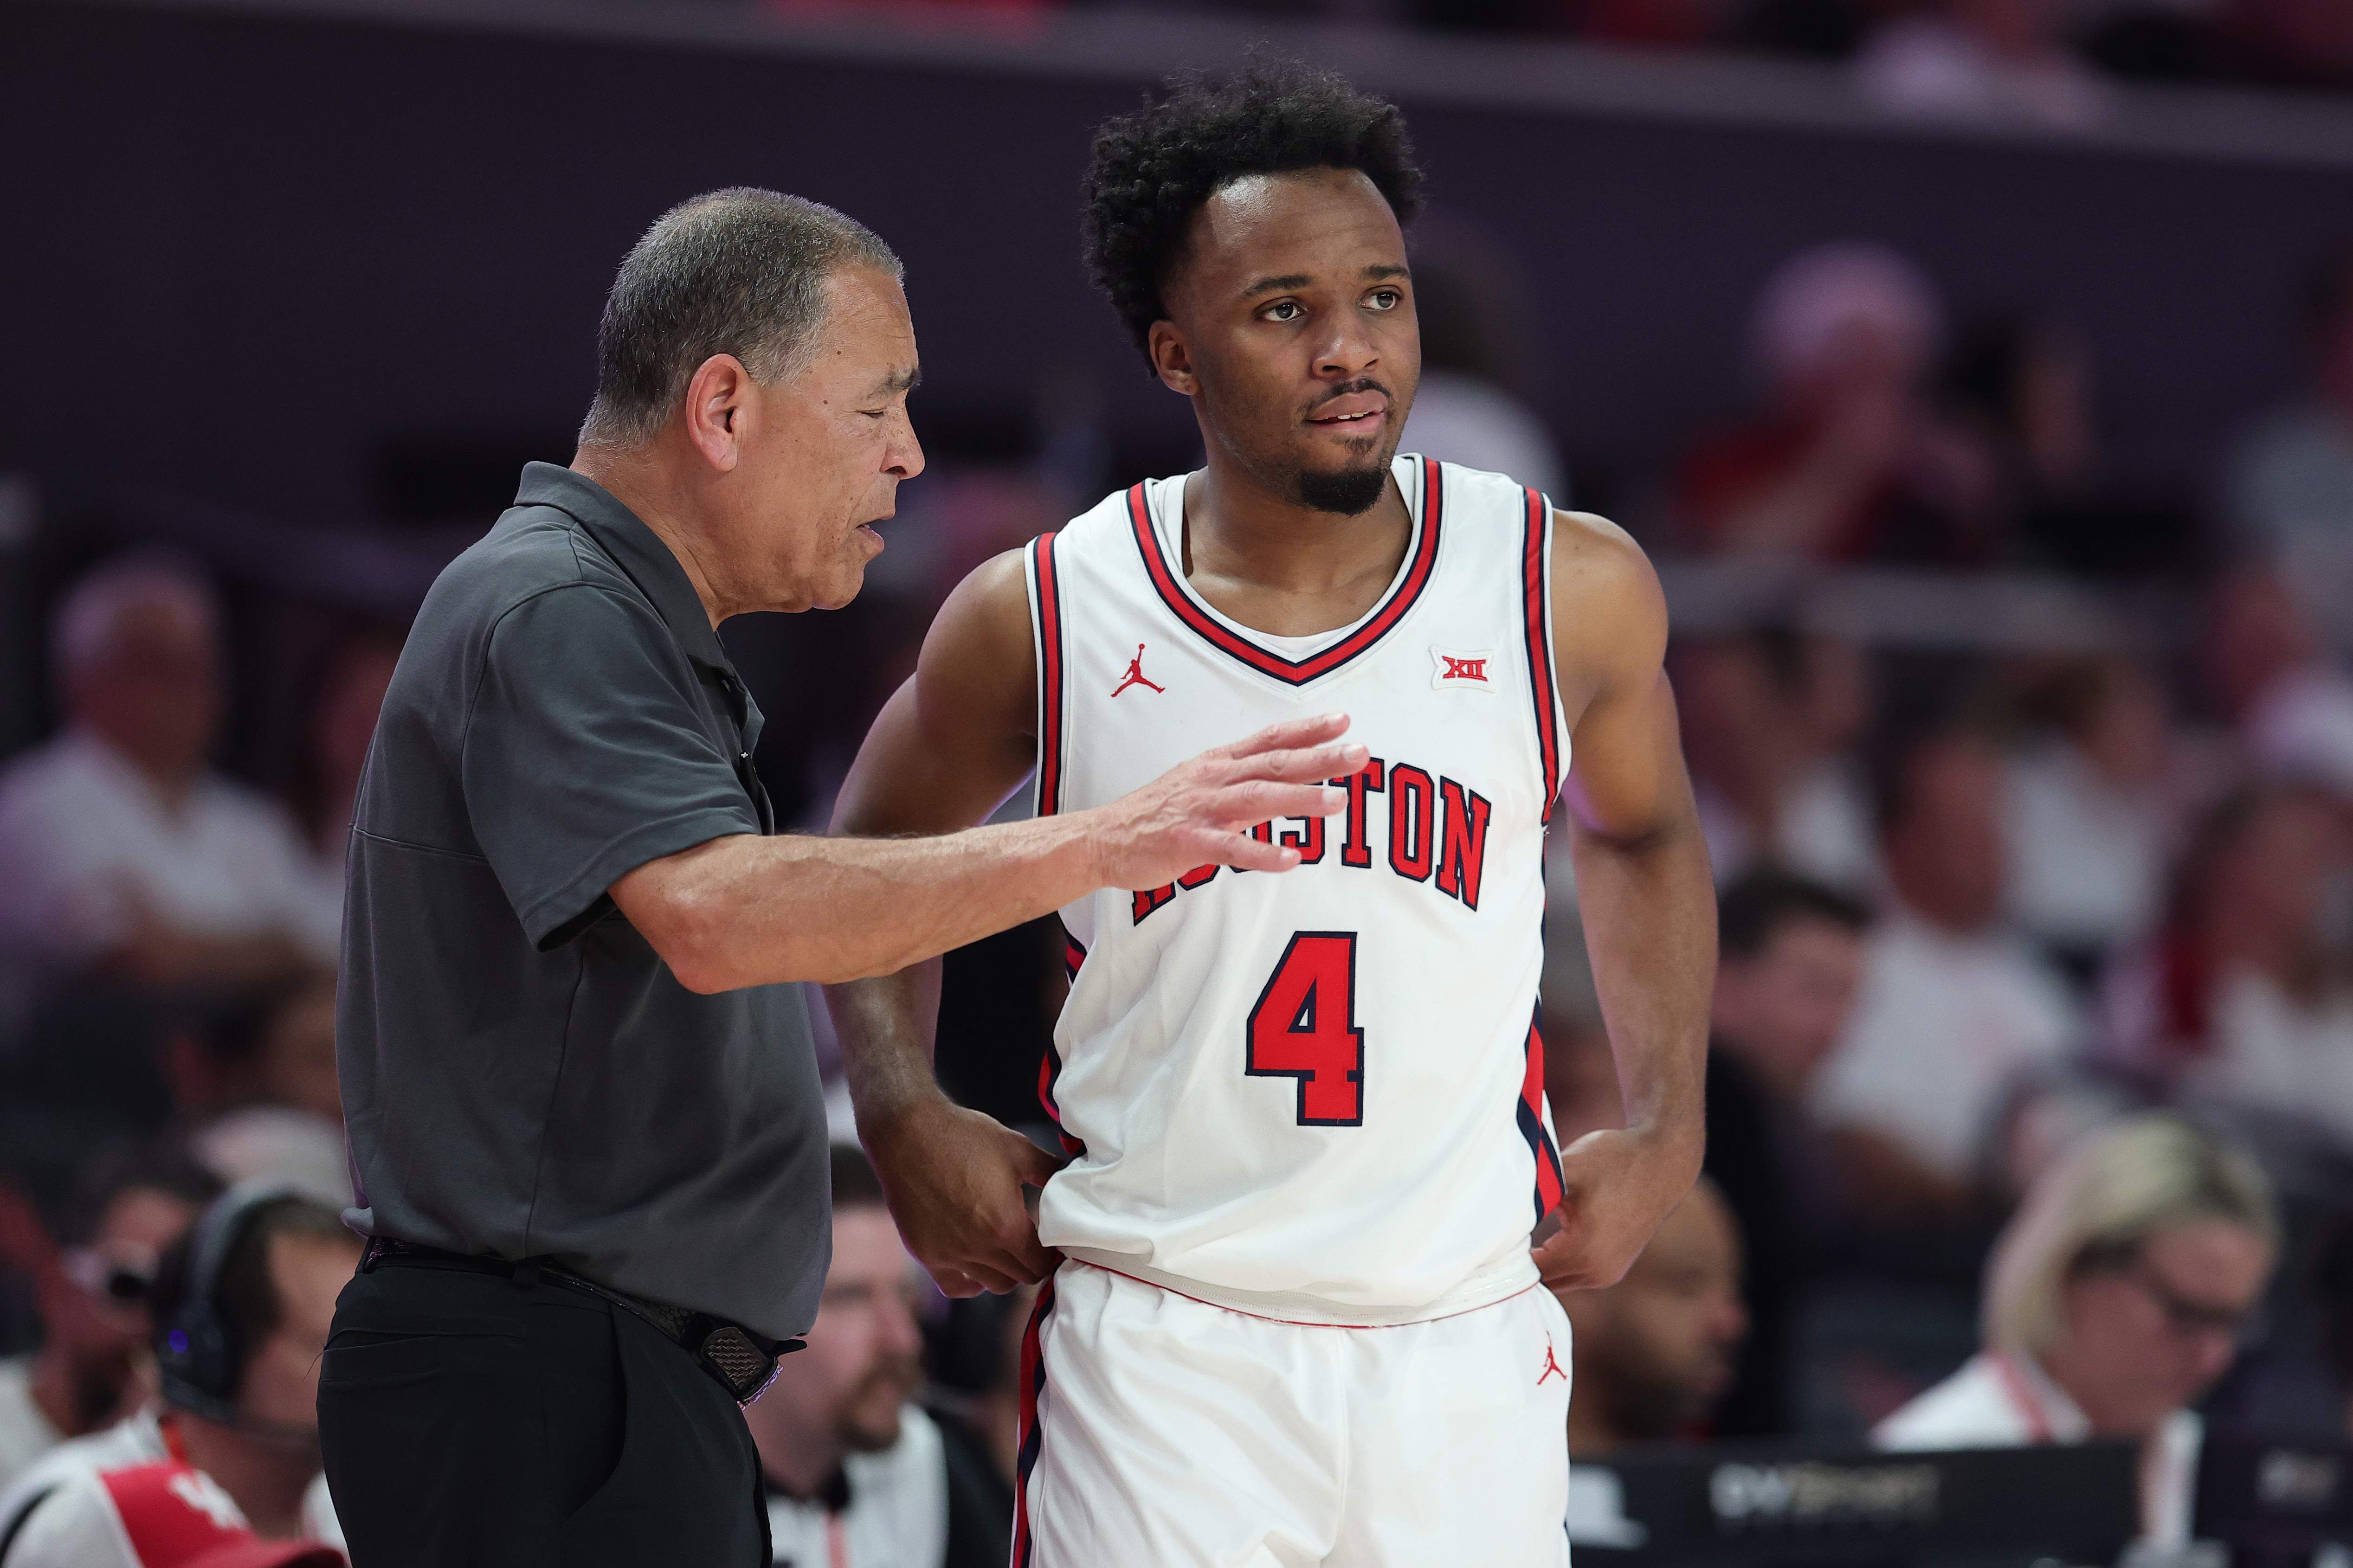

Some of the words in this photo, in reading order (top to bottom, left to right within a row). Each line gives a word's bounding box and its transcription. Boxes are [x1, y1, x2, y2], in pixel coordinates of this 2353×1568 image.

[1442, 655, 1488, 681] XII
[1132, 757, 1491, 926] STON
[1245, 931, 1364, 1126] 4
